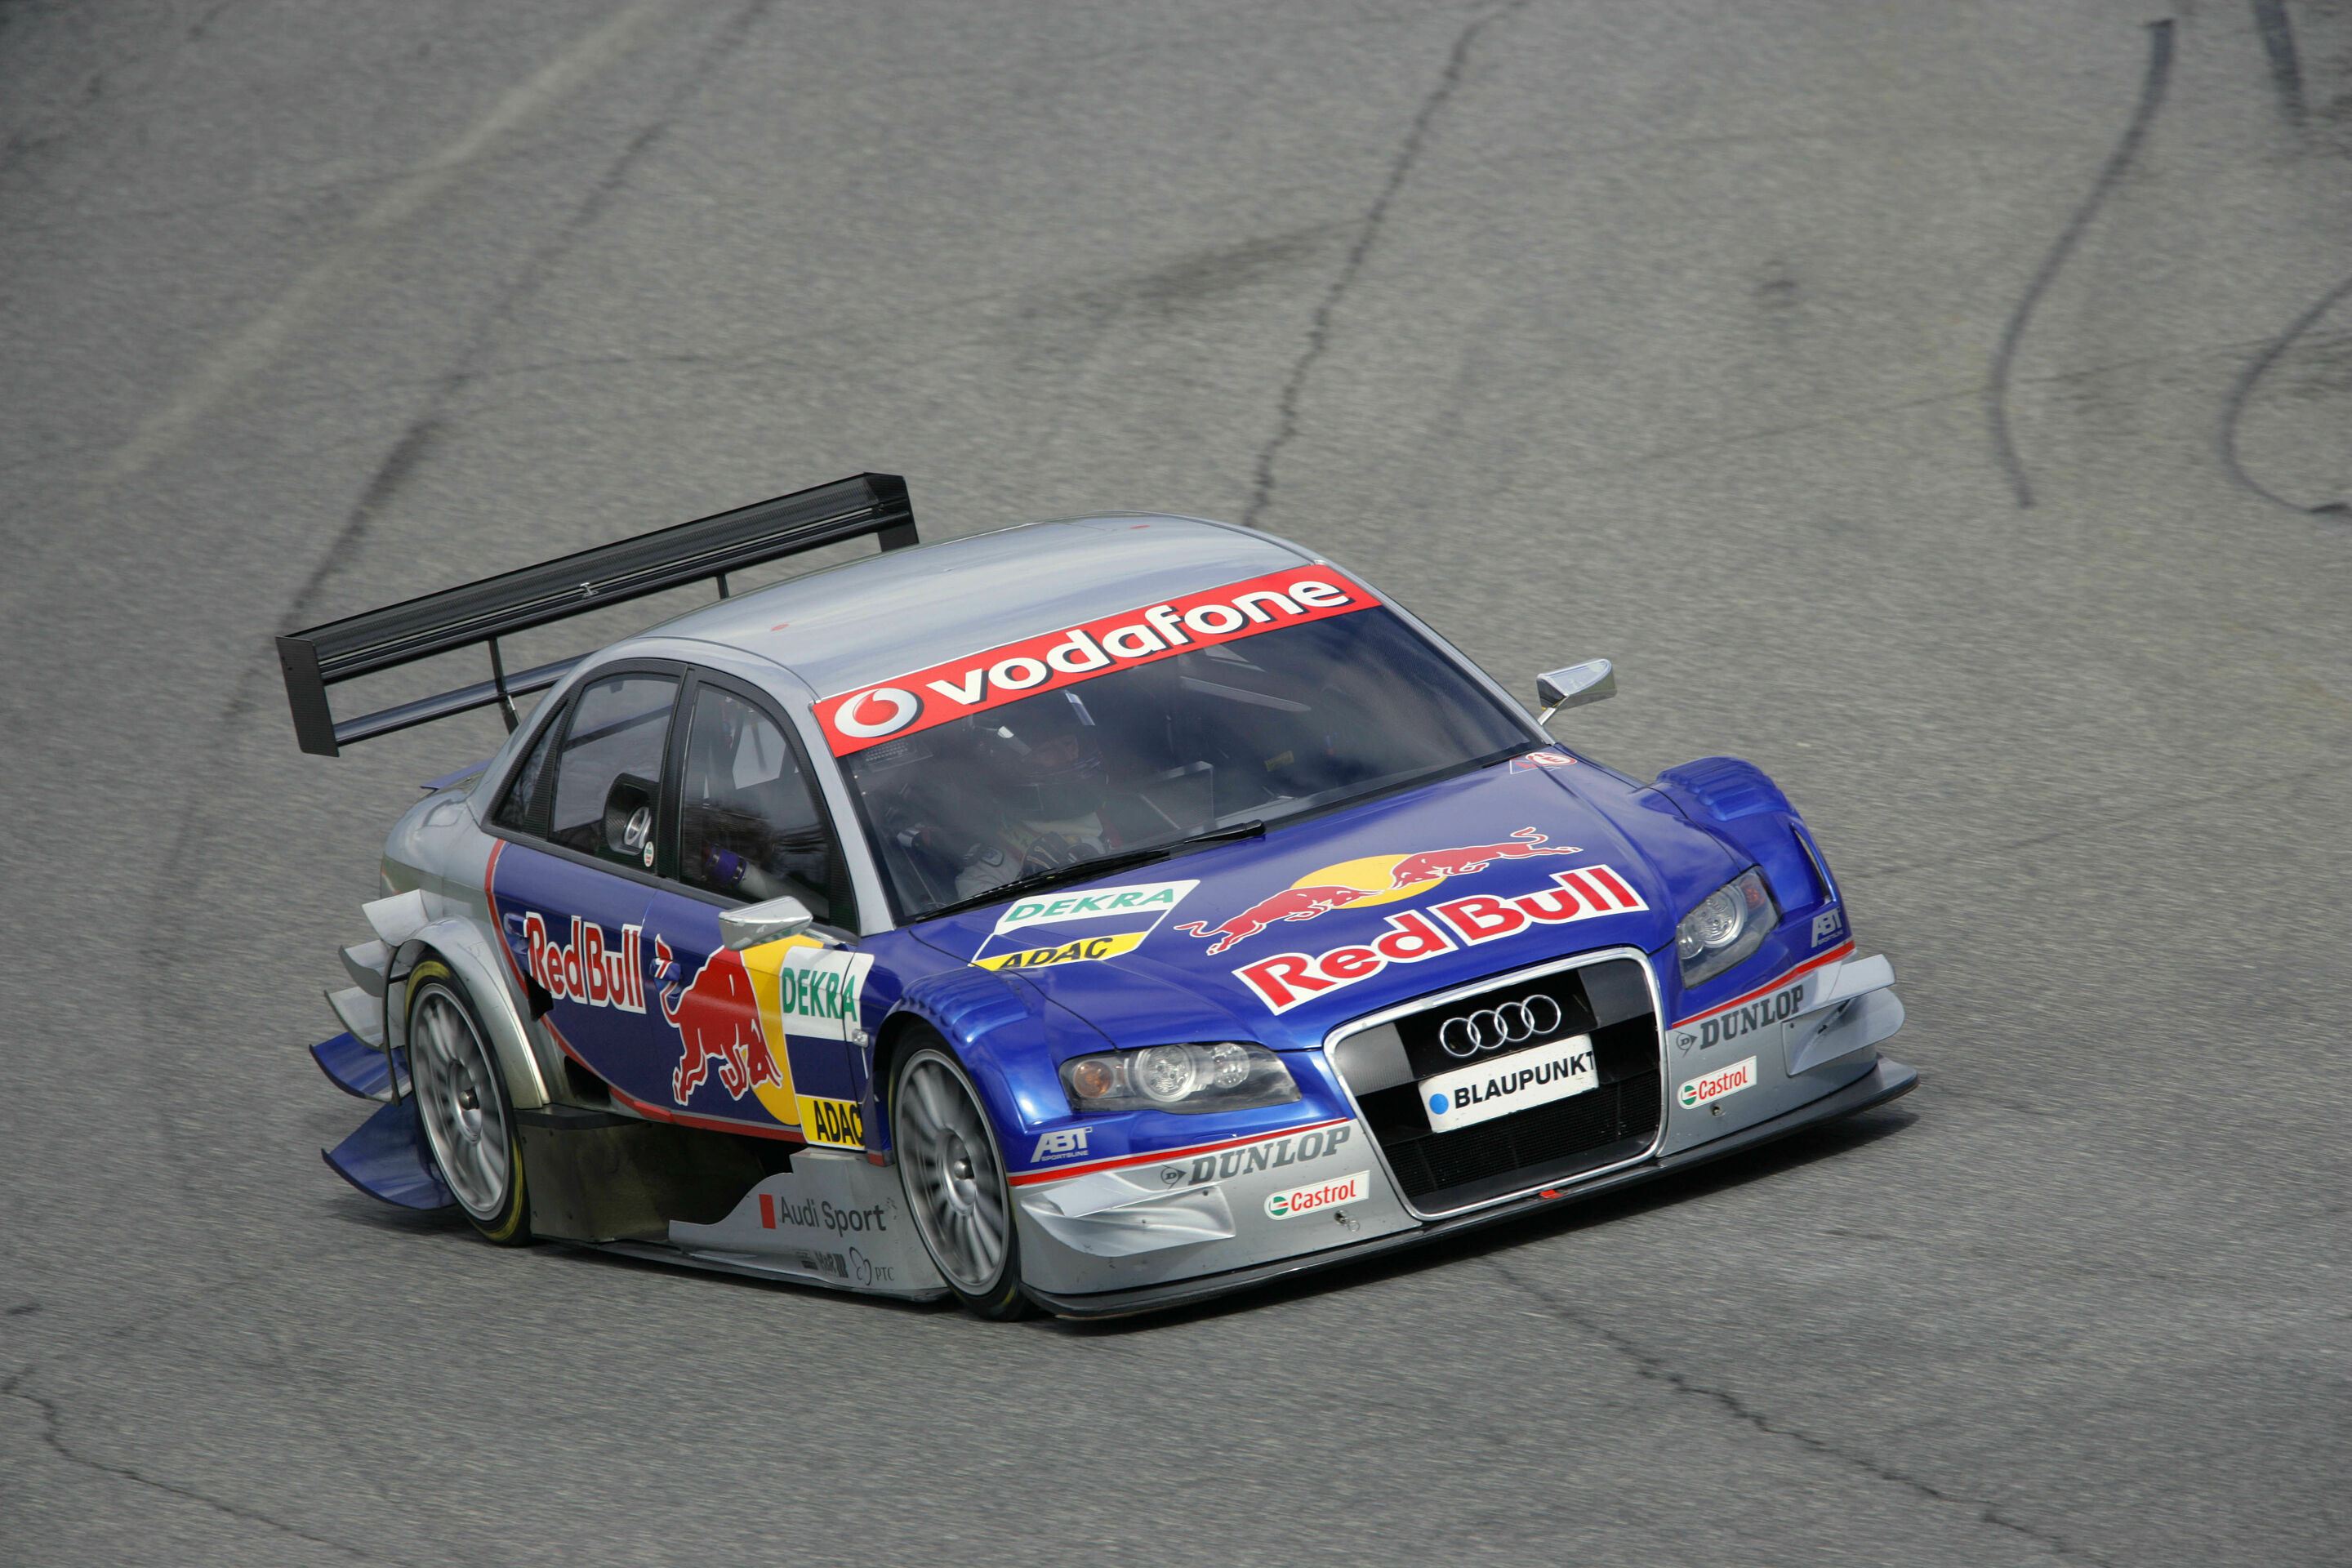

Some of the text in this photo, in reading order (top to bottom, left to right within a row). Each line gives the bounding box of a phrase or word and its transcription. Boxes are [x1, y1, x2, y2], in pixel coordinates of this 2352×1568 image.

[926, 580, 1352, 706] vodafone
[1005, 888, 1174, 922] DEKRA
[1811, 906, 1842, 948] ABT
[998, 938, 1113, 969] ADAC
[1241, 866, 1640, 1009] Red Bull
[527, 915, 646, 1014] Red Bull
[783, 967, 858, 1022] DEKRA
[1699, 984, 1804, 1050] DUNLOP
[1454, 1050, 1594, 1109] BLAUPUNKT
[1699, 1066, 1748, 1100] Castrol
[813, 1100, 864, 1146] ADAC
[1030, 1127, 1093, 1163] ABT
[1188, 1126, 1351, 1186] DUNLOP
[781, 1196, 887, 1238] Audi Sport
[1290, 1179, 1356, 1211] Castrol
[875, 1267, 895, 1281] PTC
